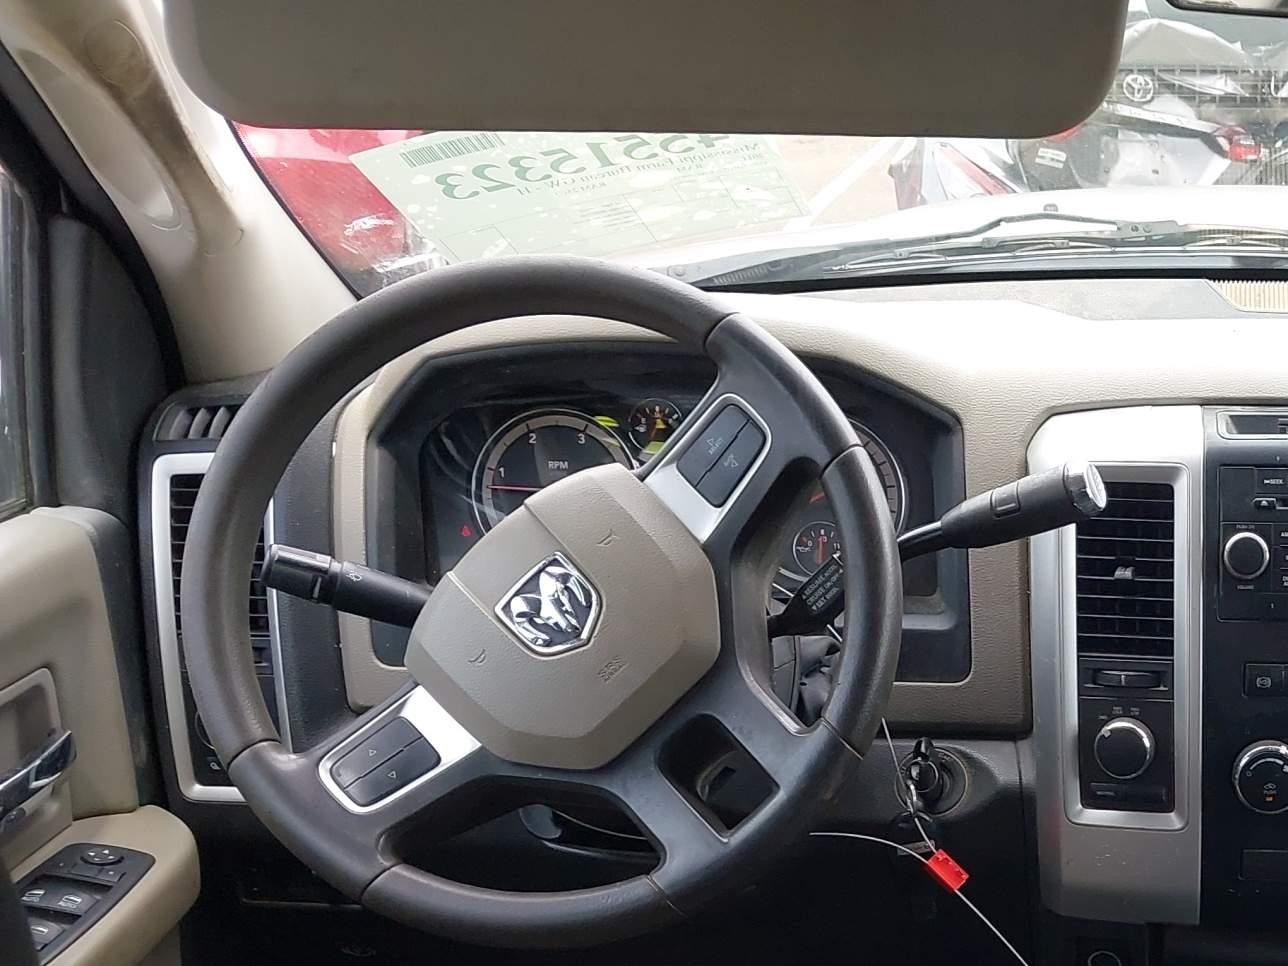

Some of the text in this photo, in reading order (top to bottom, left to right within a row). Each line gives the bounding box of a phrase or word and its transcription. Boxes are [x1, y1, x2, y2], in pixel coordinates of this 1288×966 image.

[528, 433, 537, 444] 2
[578, 433, 586, 444] 3
[548, 460, 569, 470] RPM
[499, 467, 505, 478] 1
